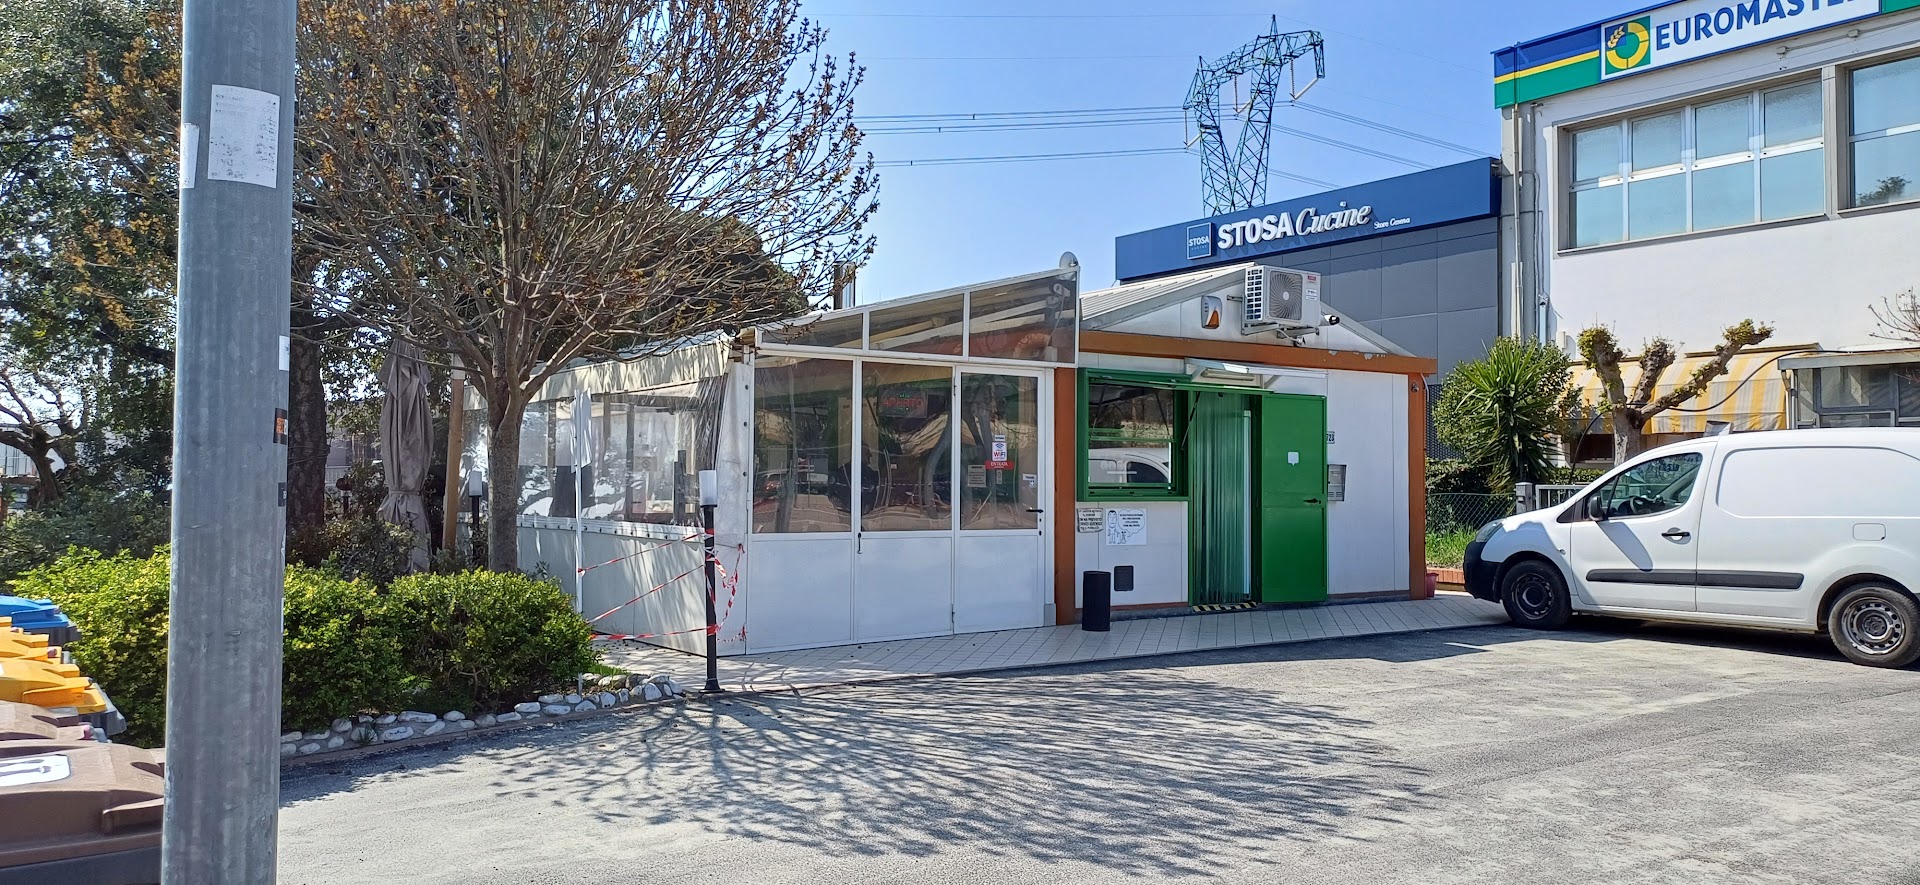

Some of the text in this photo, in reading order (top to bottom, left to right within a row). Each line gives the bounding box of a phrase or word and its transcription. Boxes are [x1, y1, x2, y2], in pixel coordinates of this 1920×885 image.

[1656, 0, 1854, 50] EUROMAS
[1188, 235, 1210, 247] STOSA
[1217, 201, 1371, 249] STOSA Cucine
